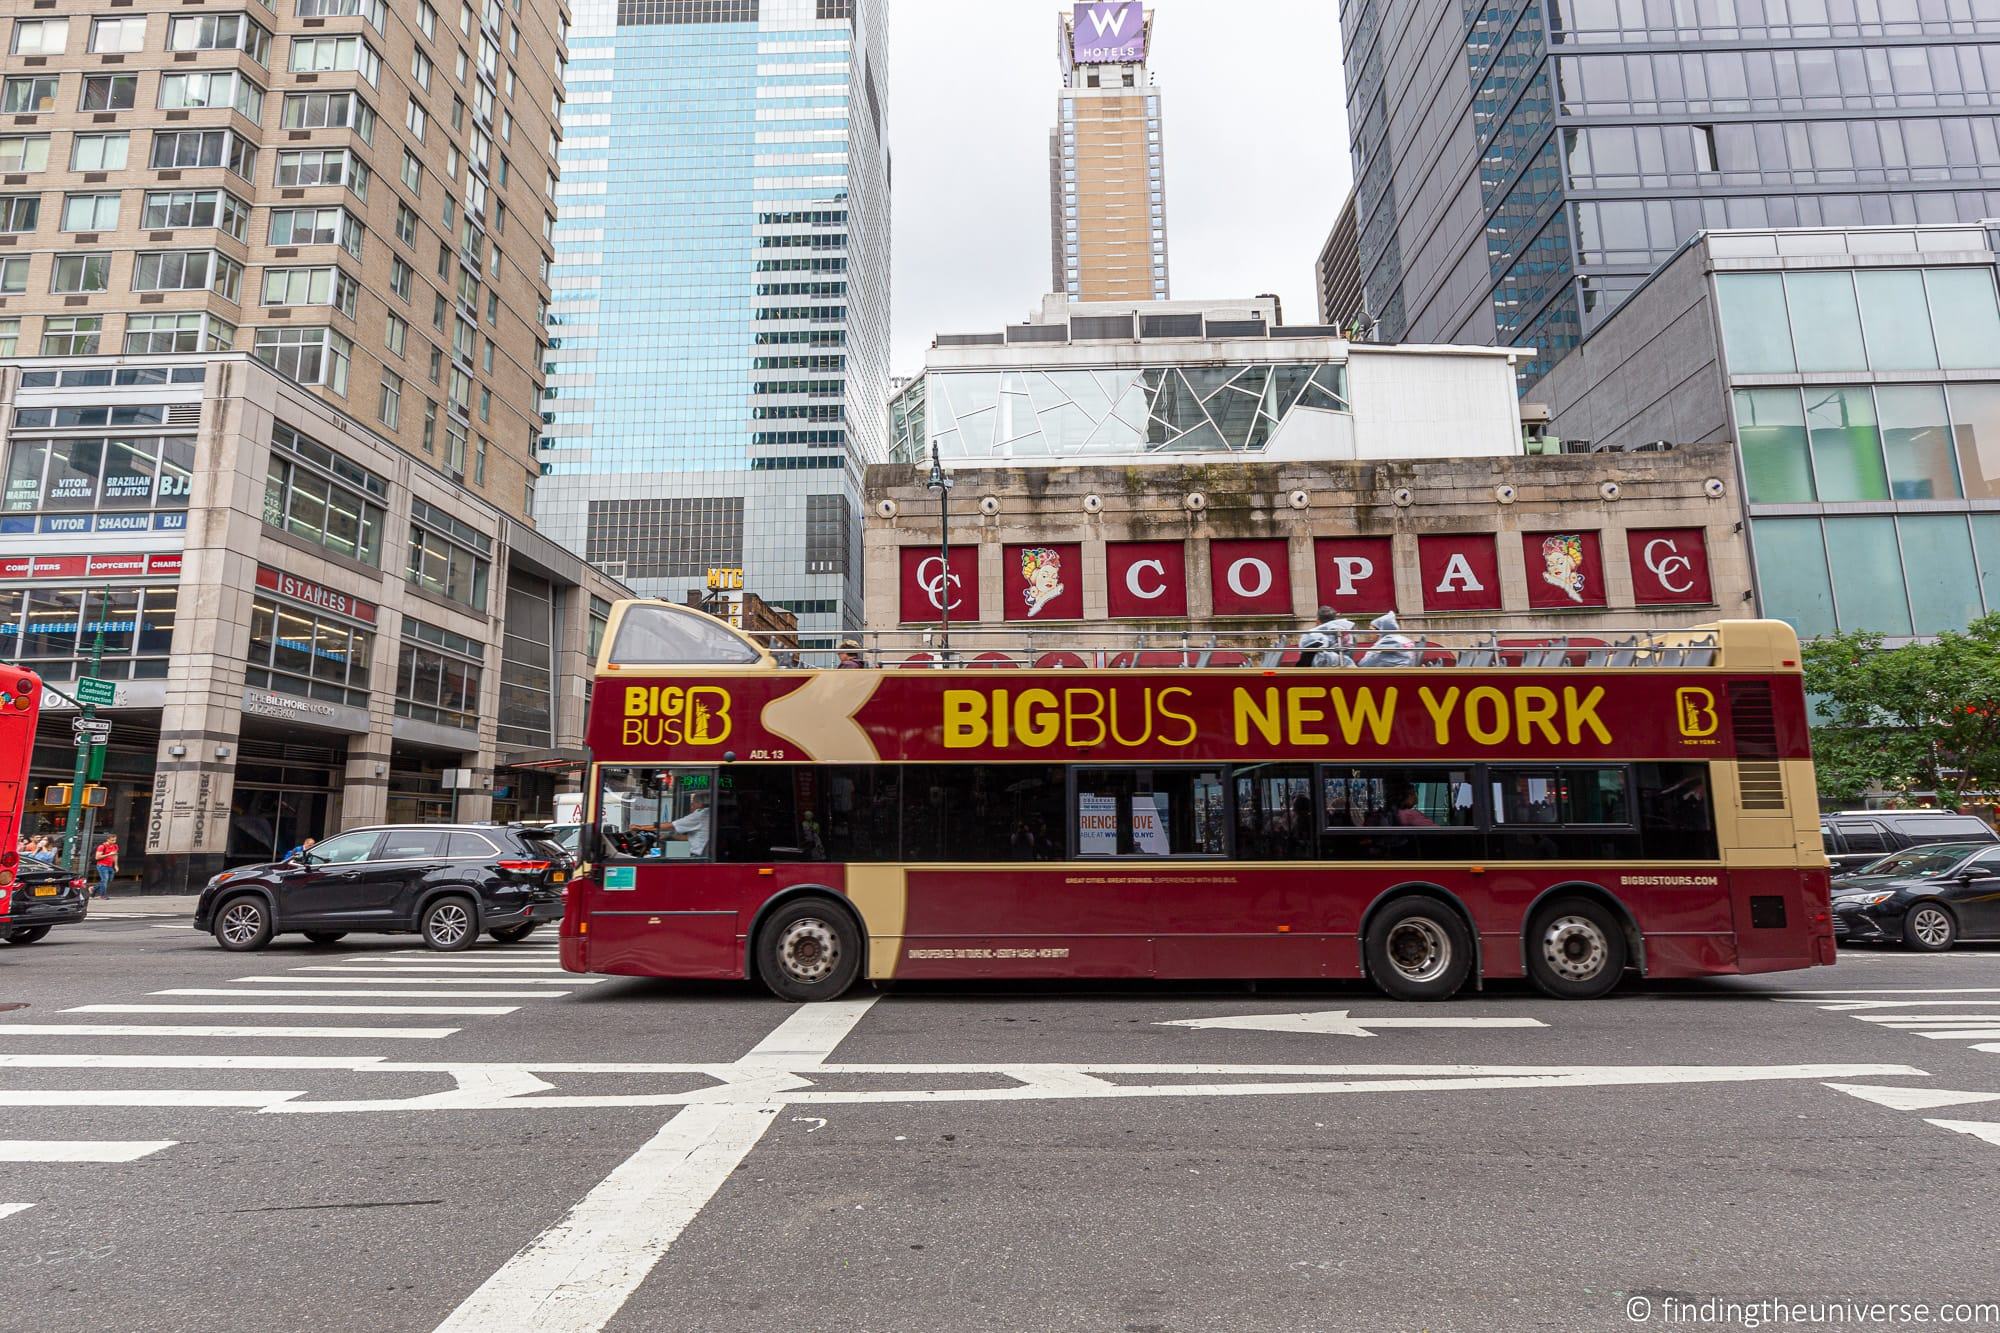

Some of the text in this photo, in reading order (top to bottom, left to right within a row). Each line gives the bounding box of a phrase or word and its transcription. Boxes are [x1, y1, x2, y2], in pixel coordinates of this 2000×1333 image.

[1087, 8, 1129, 37] W
[1083, 47, 1135, 57] HOTELS
[12, 479, 37, 489] MIXED
[58, 478, 88, 488] VITOR
[106, 476, 151, 487] BRAZILIAN
[158, 476, 192, 496] BJJ
[6, 490, 39, 500] MARTIAL
[51, 488, 92, 498] SHAOLIN
[106, 486, 149, 497] JIU JITSU
[11, 502, 32, 511] ARTS
[51, 516, 183, 531] VITOR SHAOLIN BJJ
[706, 567, 743, 588] MTC
[284, 577, 346, 612] STAPLES
[624, 686, 684, 717] BIG
[1233, 686, 1398, 746] NEW
[1418, 686, 1613, 746] YORK
[622, 718, 684, 746] BUS
[750, 750, 784, 759] ADL 13
[148, 780, 167, 849] BILTMORE
[193, 778, 210, 848] BILTMORE
[1081, 815, 1154, 830] RIENCE OVE
[1133, 831, 1155, 839] O.NYC
[1620, 876, 1719, 886] BIGBUSTOURS.COM
